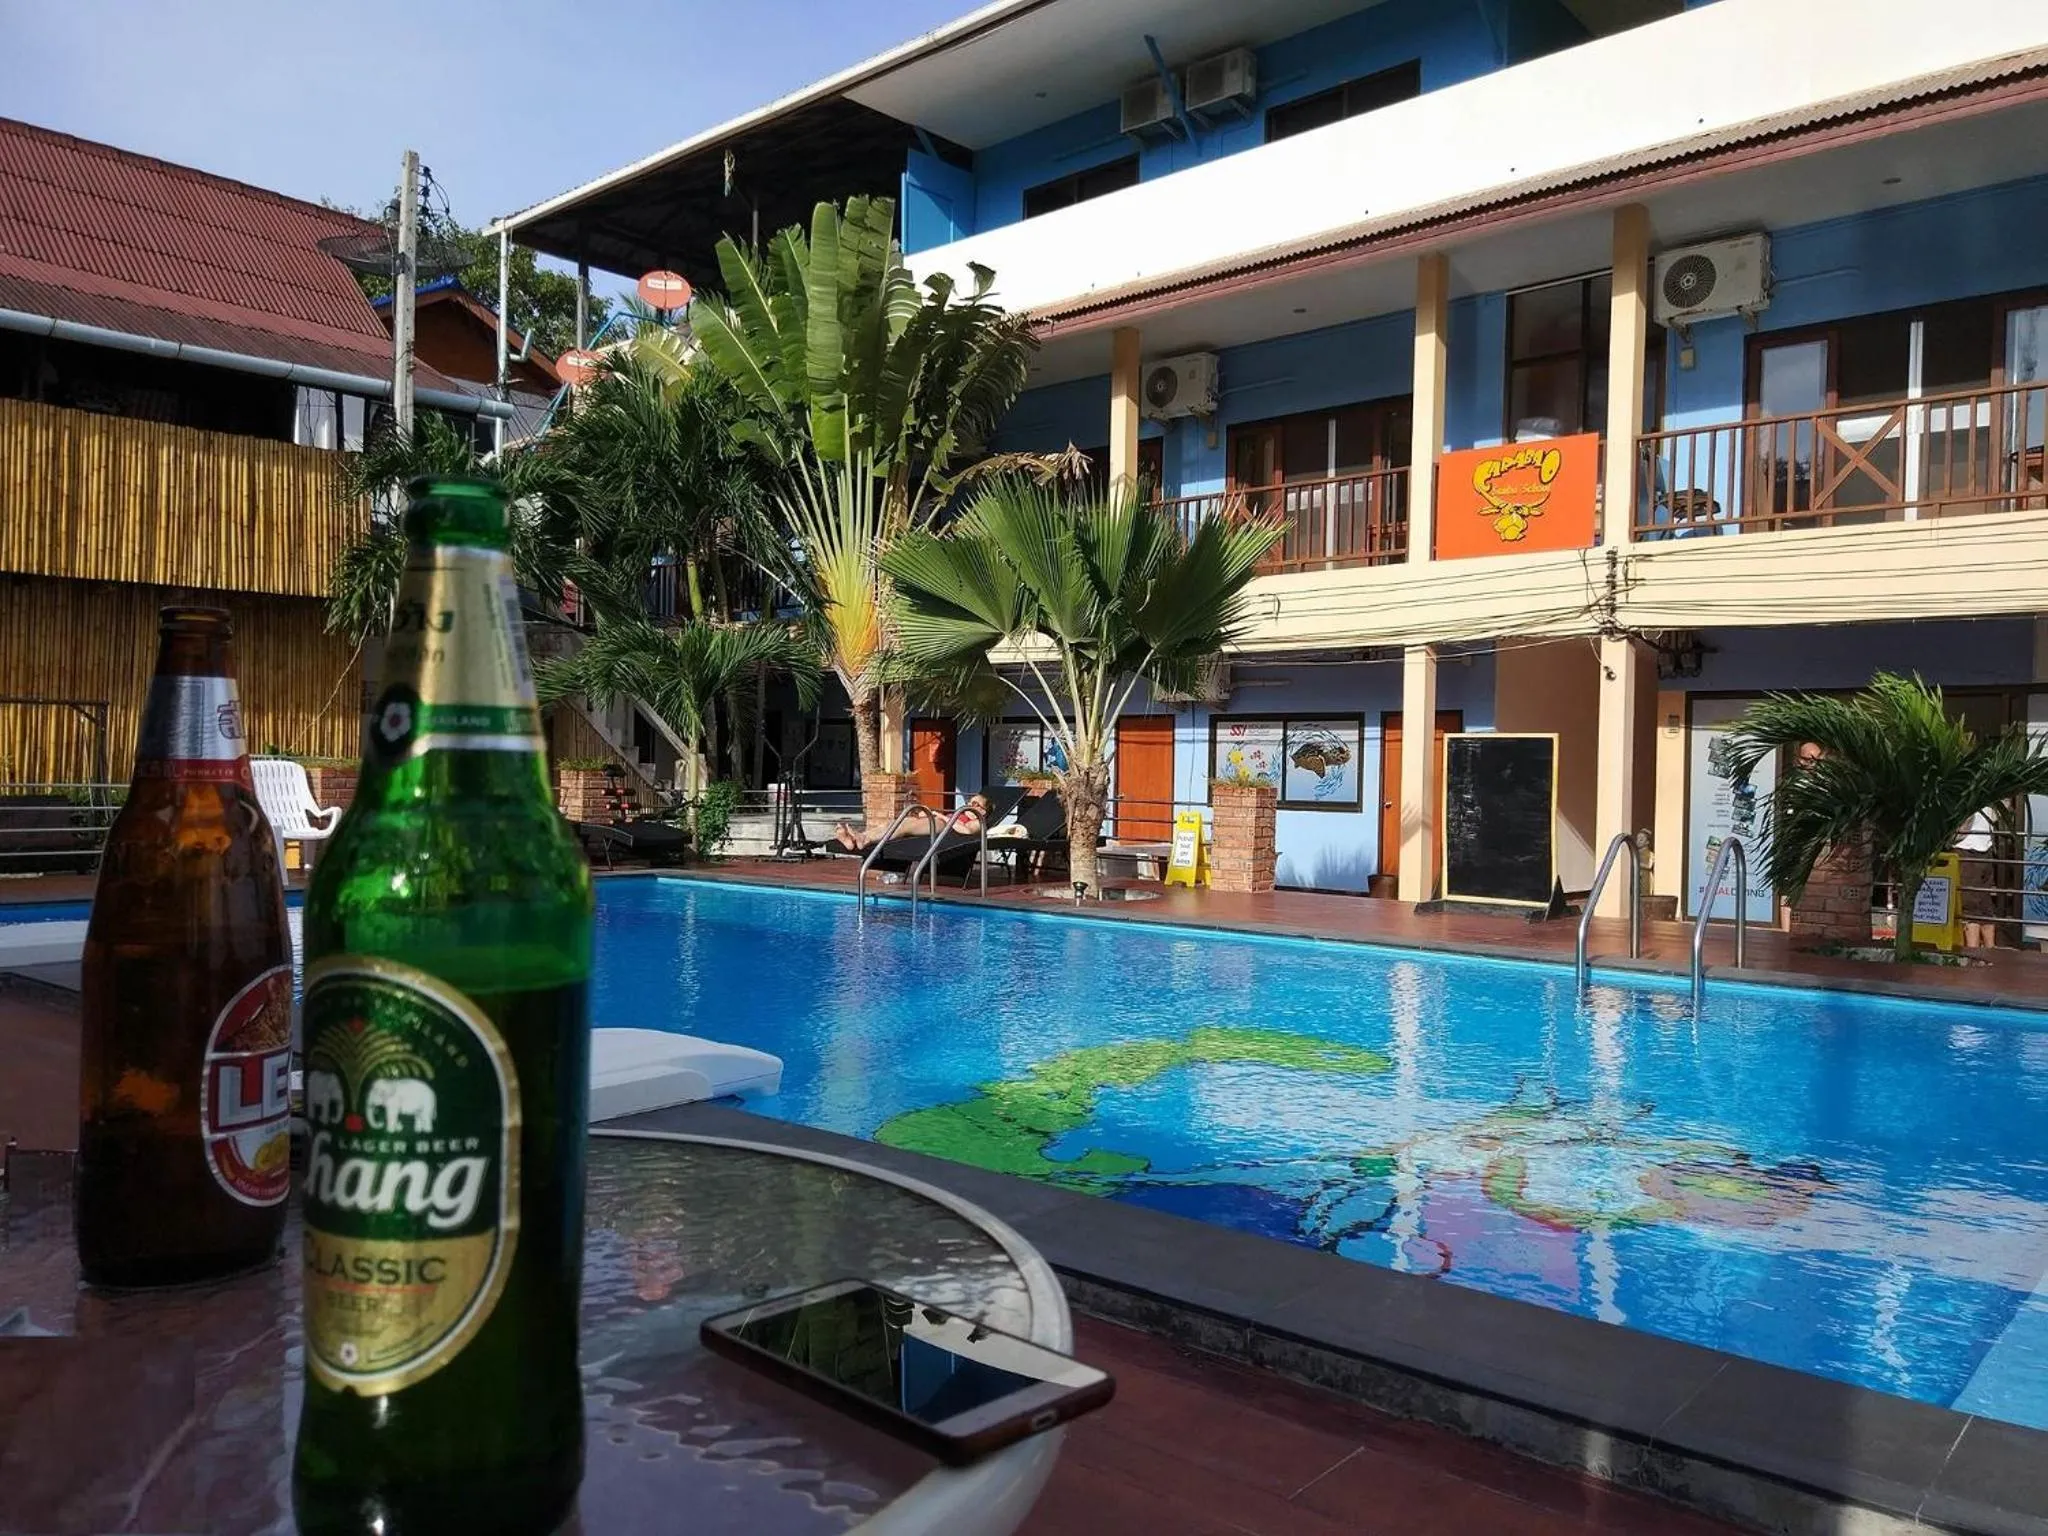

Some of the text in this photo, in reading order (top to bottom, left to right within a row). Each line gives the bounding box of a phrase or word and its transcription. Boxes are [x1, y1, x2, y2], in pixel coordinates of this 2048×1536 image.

[337, 1136, 480, 1154] LAGER BEER
[302, 1130, 489, 1230] hang
